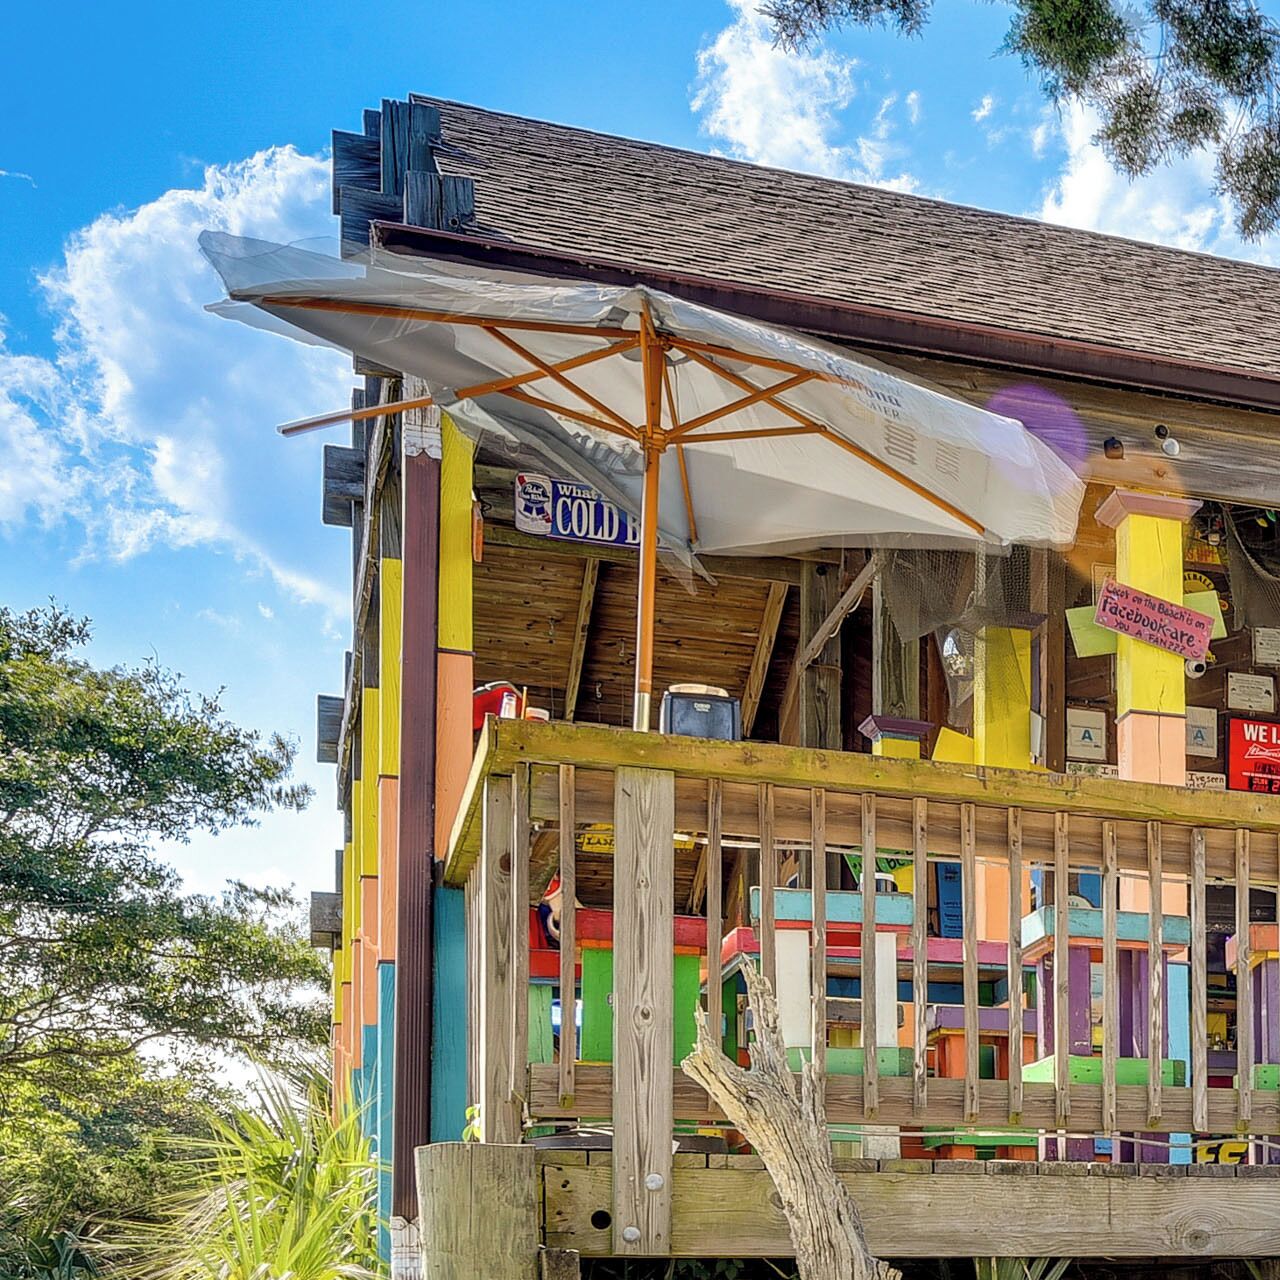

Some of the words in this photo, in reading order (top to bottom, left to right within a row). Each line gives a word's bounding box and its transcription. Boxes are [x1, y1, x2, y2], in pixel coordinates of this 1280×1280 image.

[556, 497, 619, 541] COLD
[1081, 729, 1093, 741] A
[1193, 729, 1205, 741] A
[1244, 723, 1268, 743] WE
